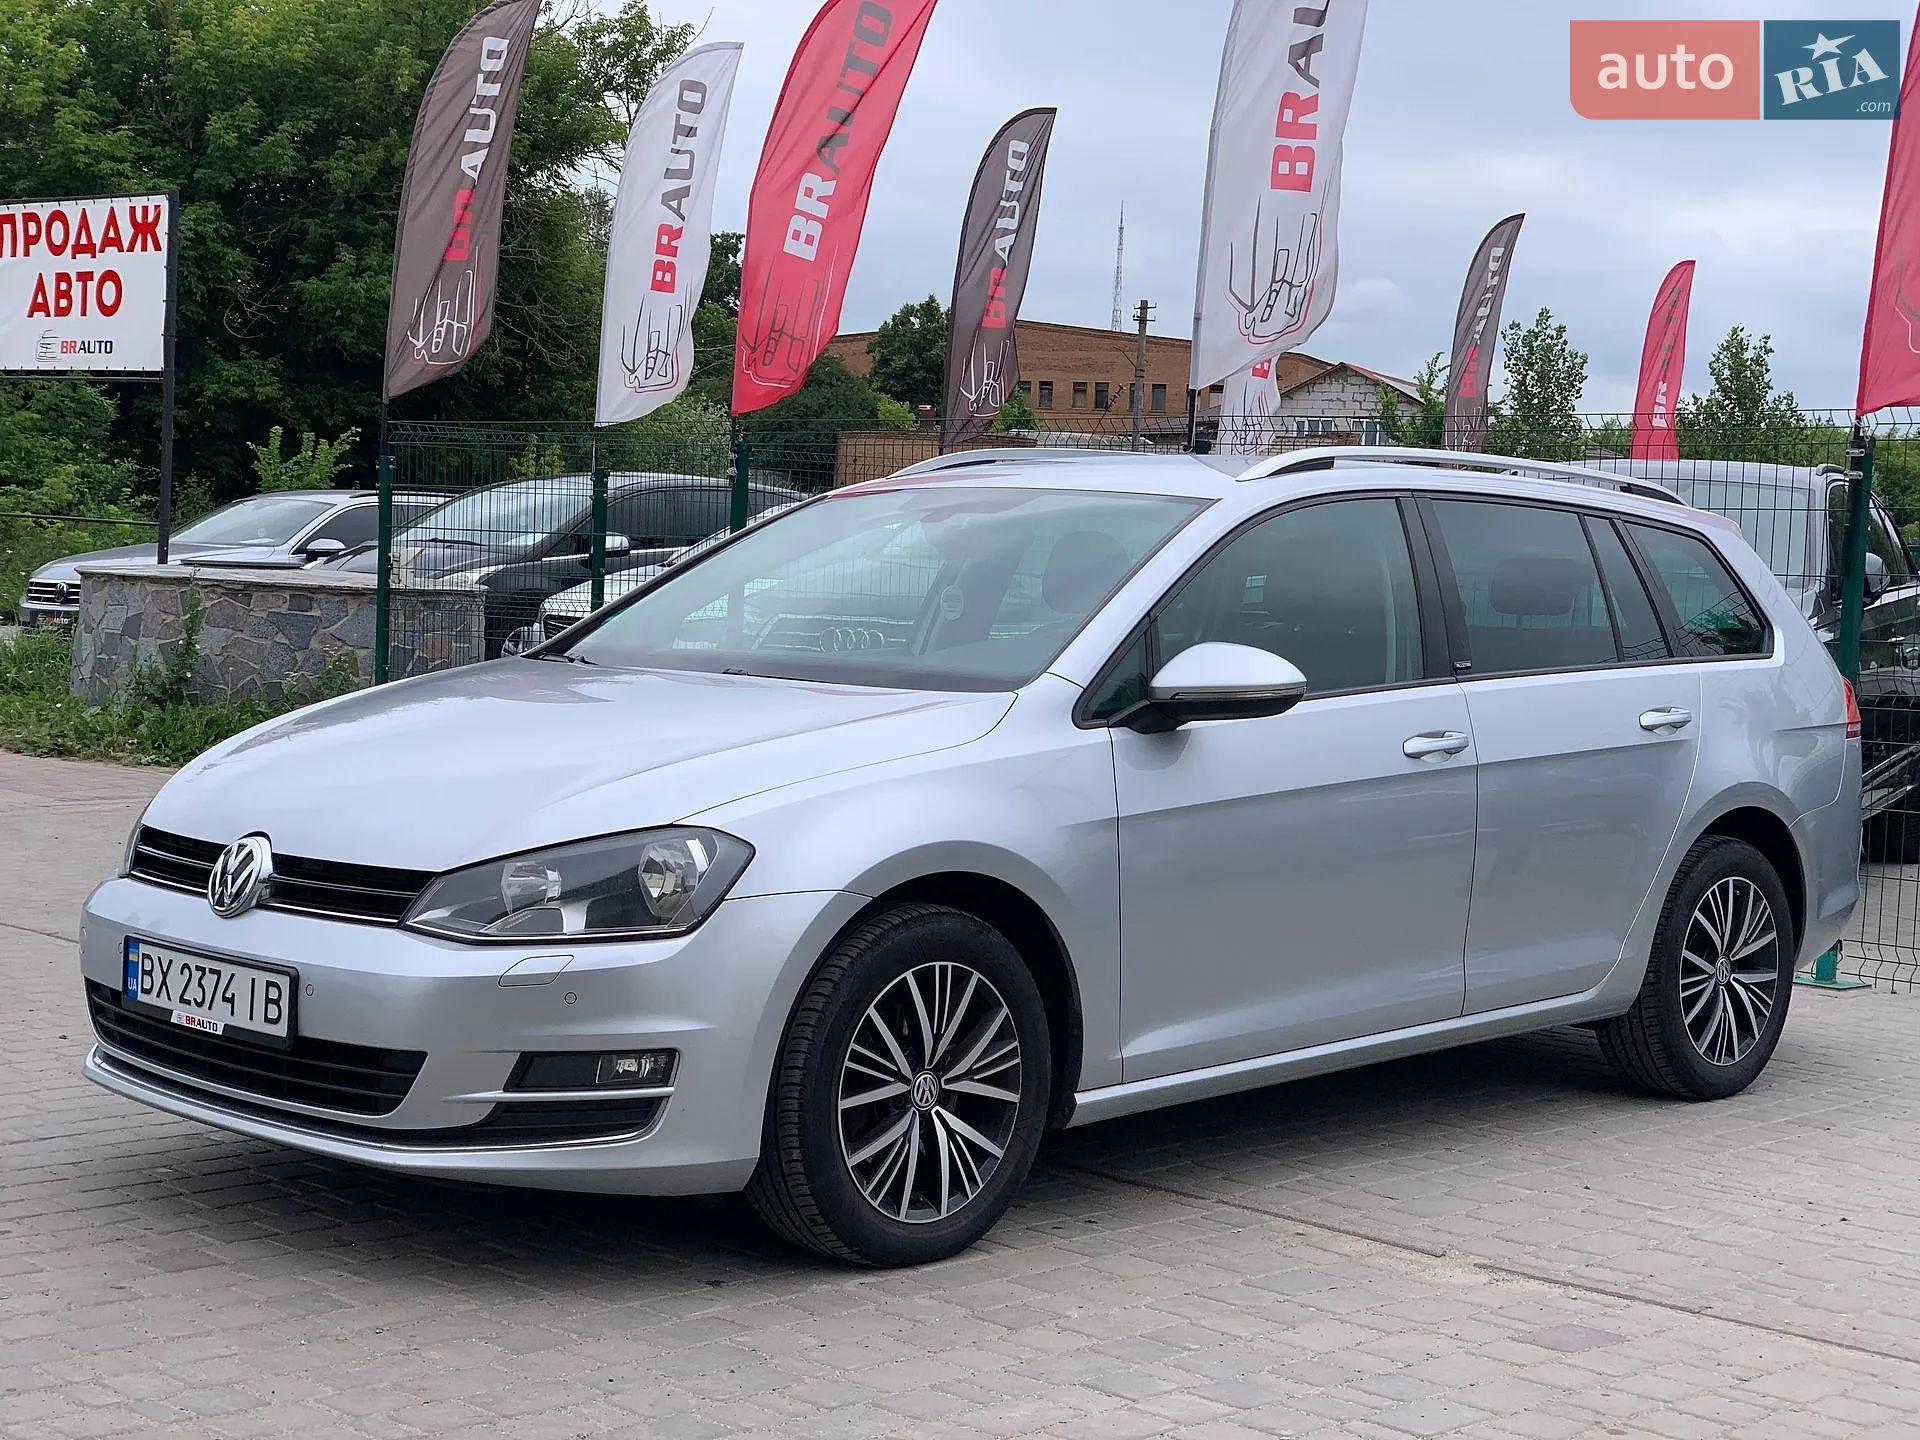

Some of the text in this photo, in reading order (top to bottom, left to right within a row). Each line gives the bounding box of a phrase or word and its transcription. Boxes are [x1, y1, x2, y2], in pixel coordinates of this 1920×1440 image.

[783, 0, 893, 262] BRAUTO
[650, 79, 708, 294] BRAUTO
[0, 204, 163, 260] ПРОДАЖ
[26, 269, 123, 319] АВТО
[60, 340, 113, 354] BRAUTO
[127, 977, 137, 991] UA
[140, 952, 283, 1025] BX 2374 IB
[185, 1016, 218, 1032] BRAUTO
